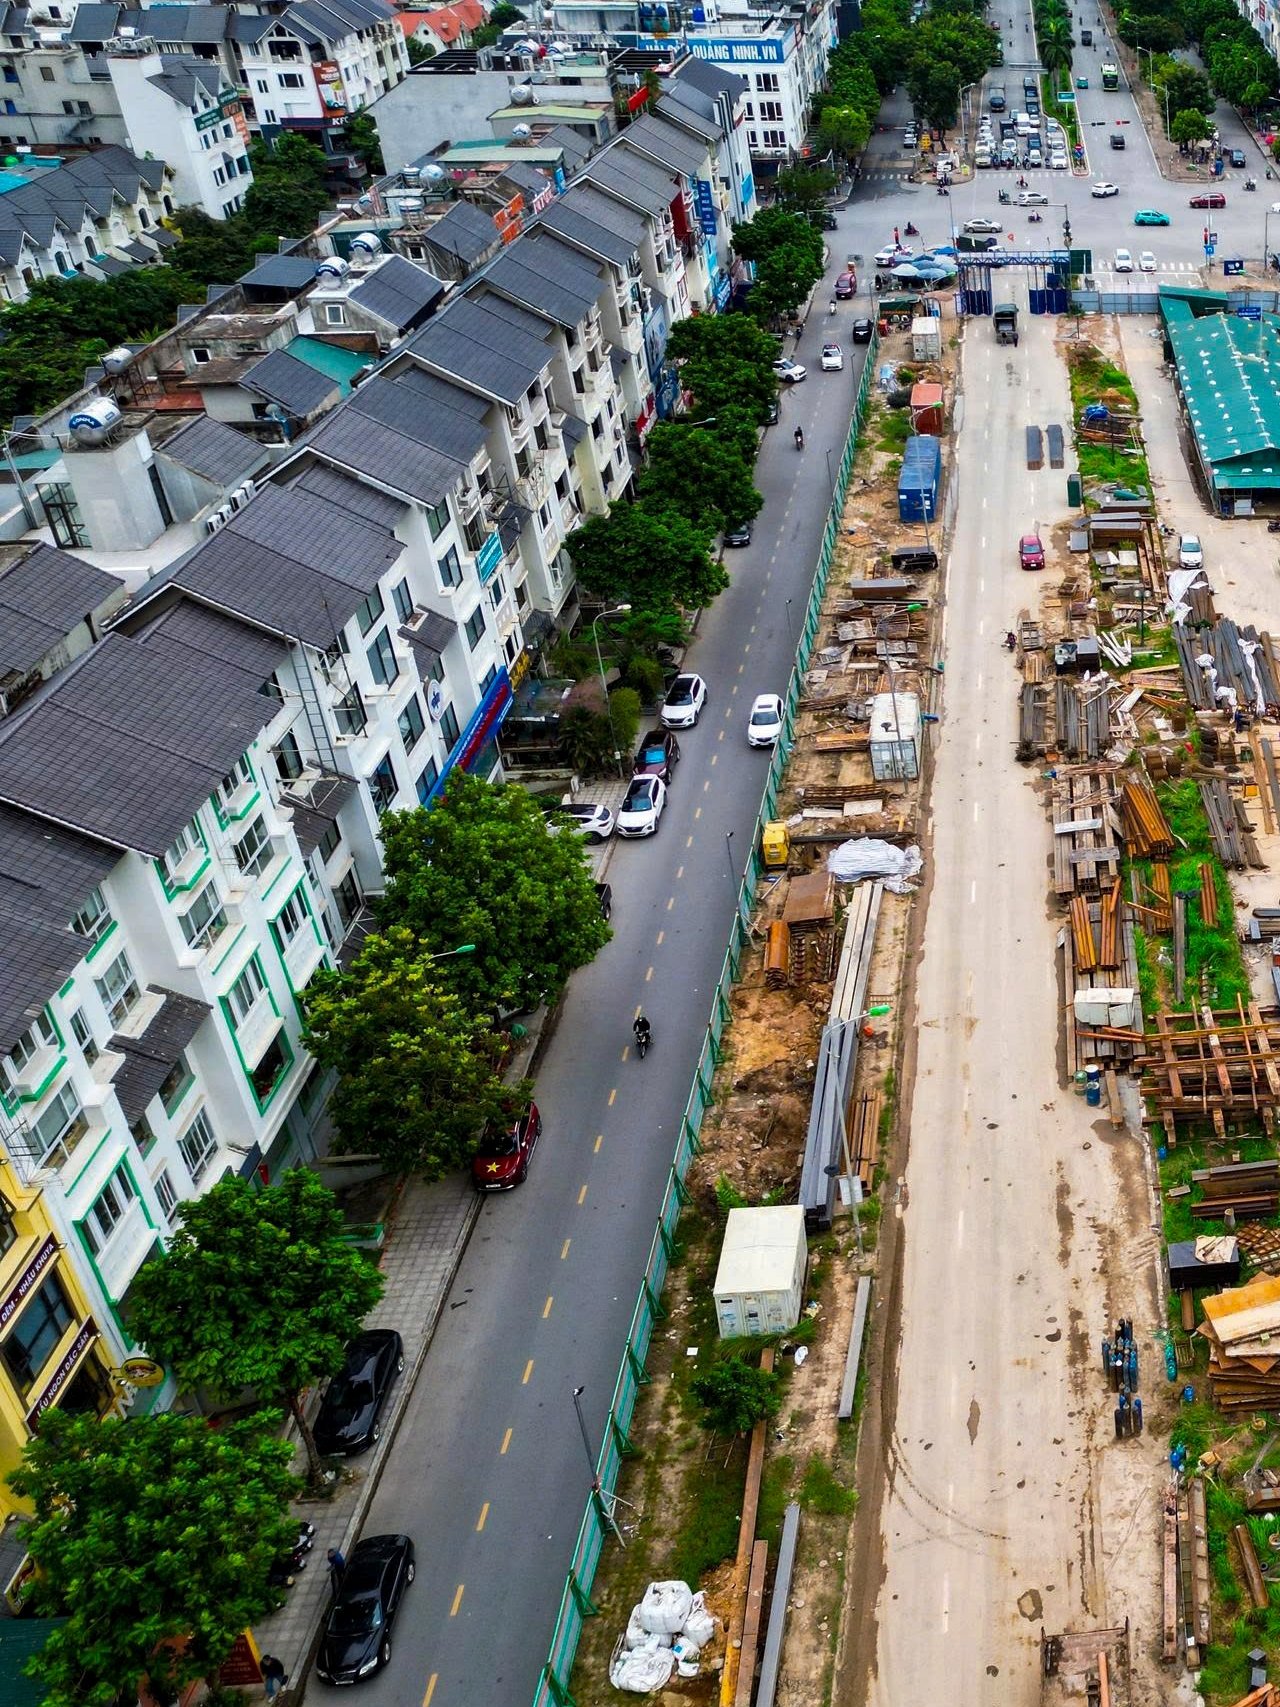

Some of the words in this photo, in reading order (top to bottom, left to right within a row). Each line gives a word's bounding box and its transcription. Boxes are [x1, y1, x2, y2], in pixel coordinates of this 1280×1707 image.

[332, 116, 349, 125] KFC
[34, 1243, 55, 1271] KHUYA
[48, 1370, 67, 1400] NGON
